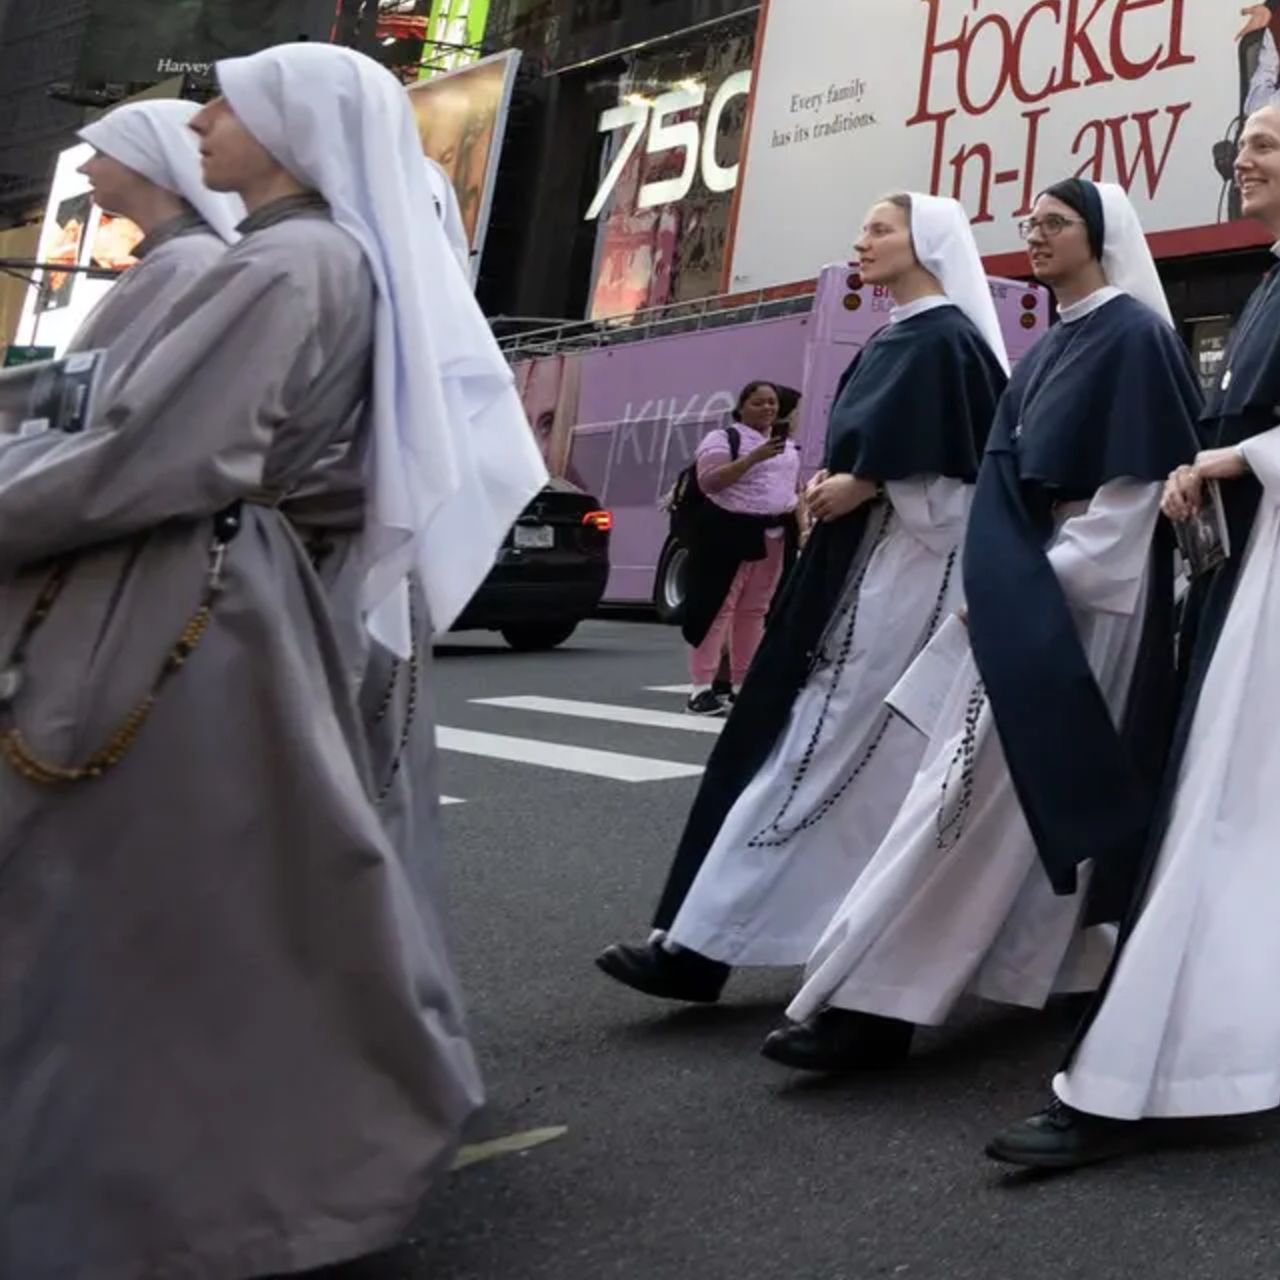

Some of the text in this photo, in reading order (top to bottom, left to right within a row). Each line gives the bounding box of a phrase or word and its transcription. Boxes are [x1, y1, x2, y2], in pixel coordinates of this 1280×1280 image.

[157, 57, 213, 76] Harvey
[790, 78, 867, 114] Every family
[771, 129, 791, 148] has
[794, 123, 809, 142] its
